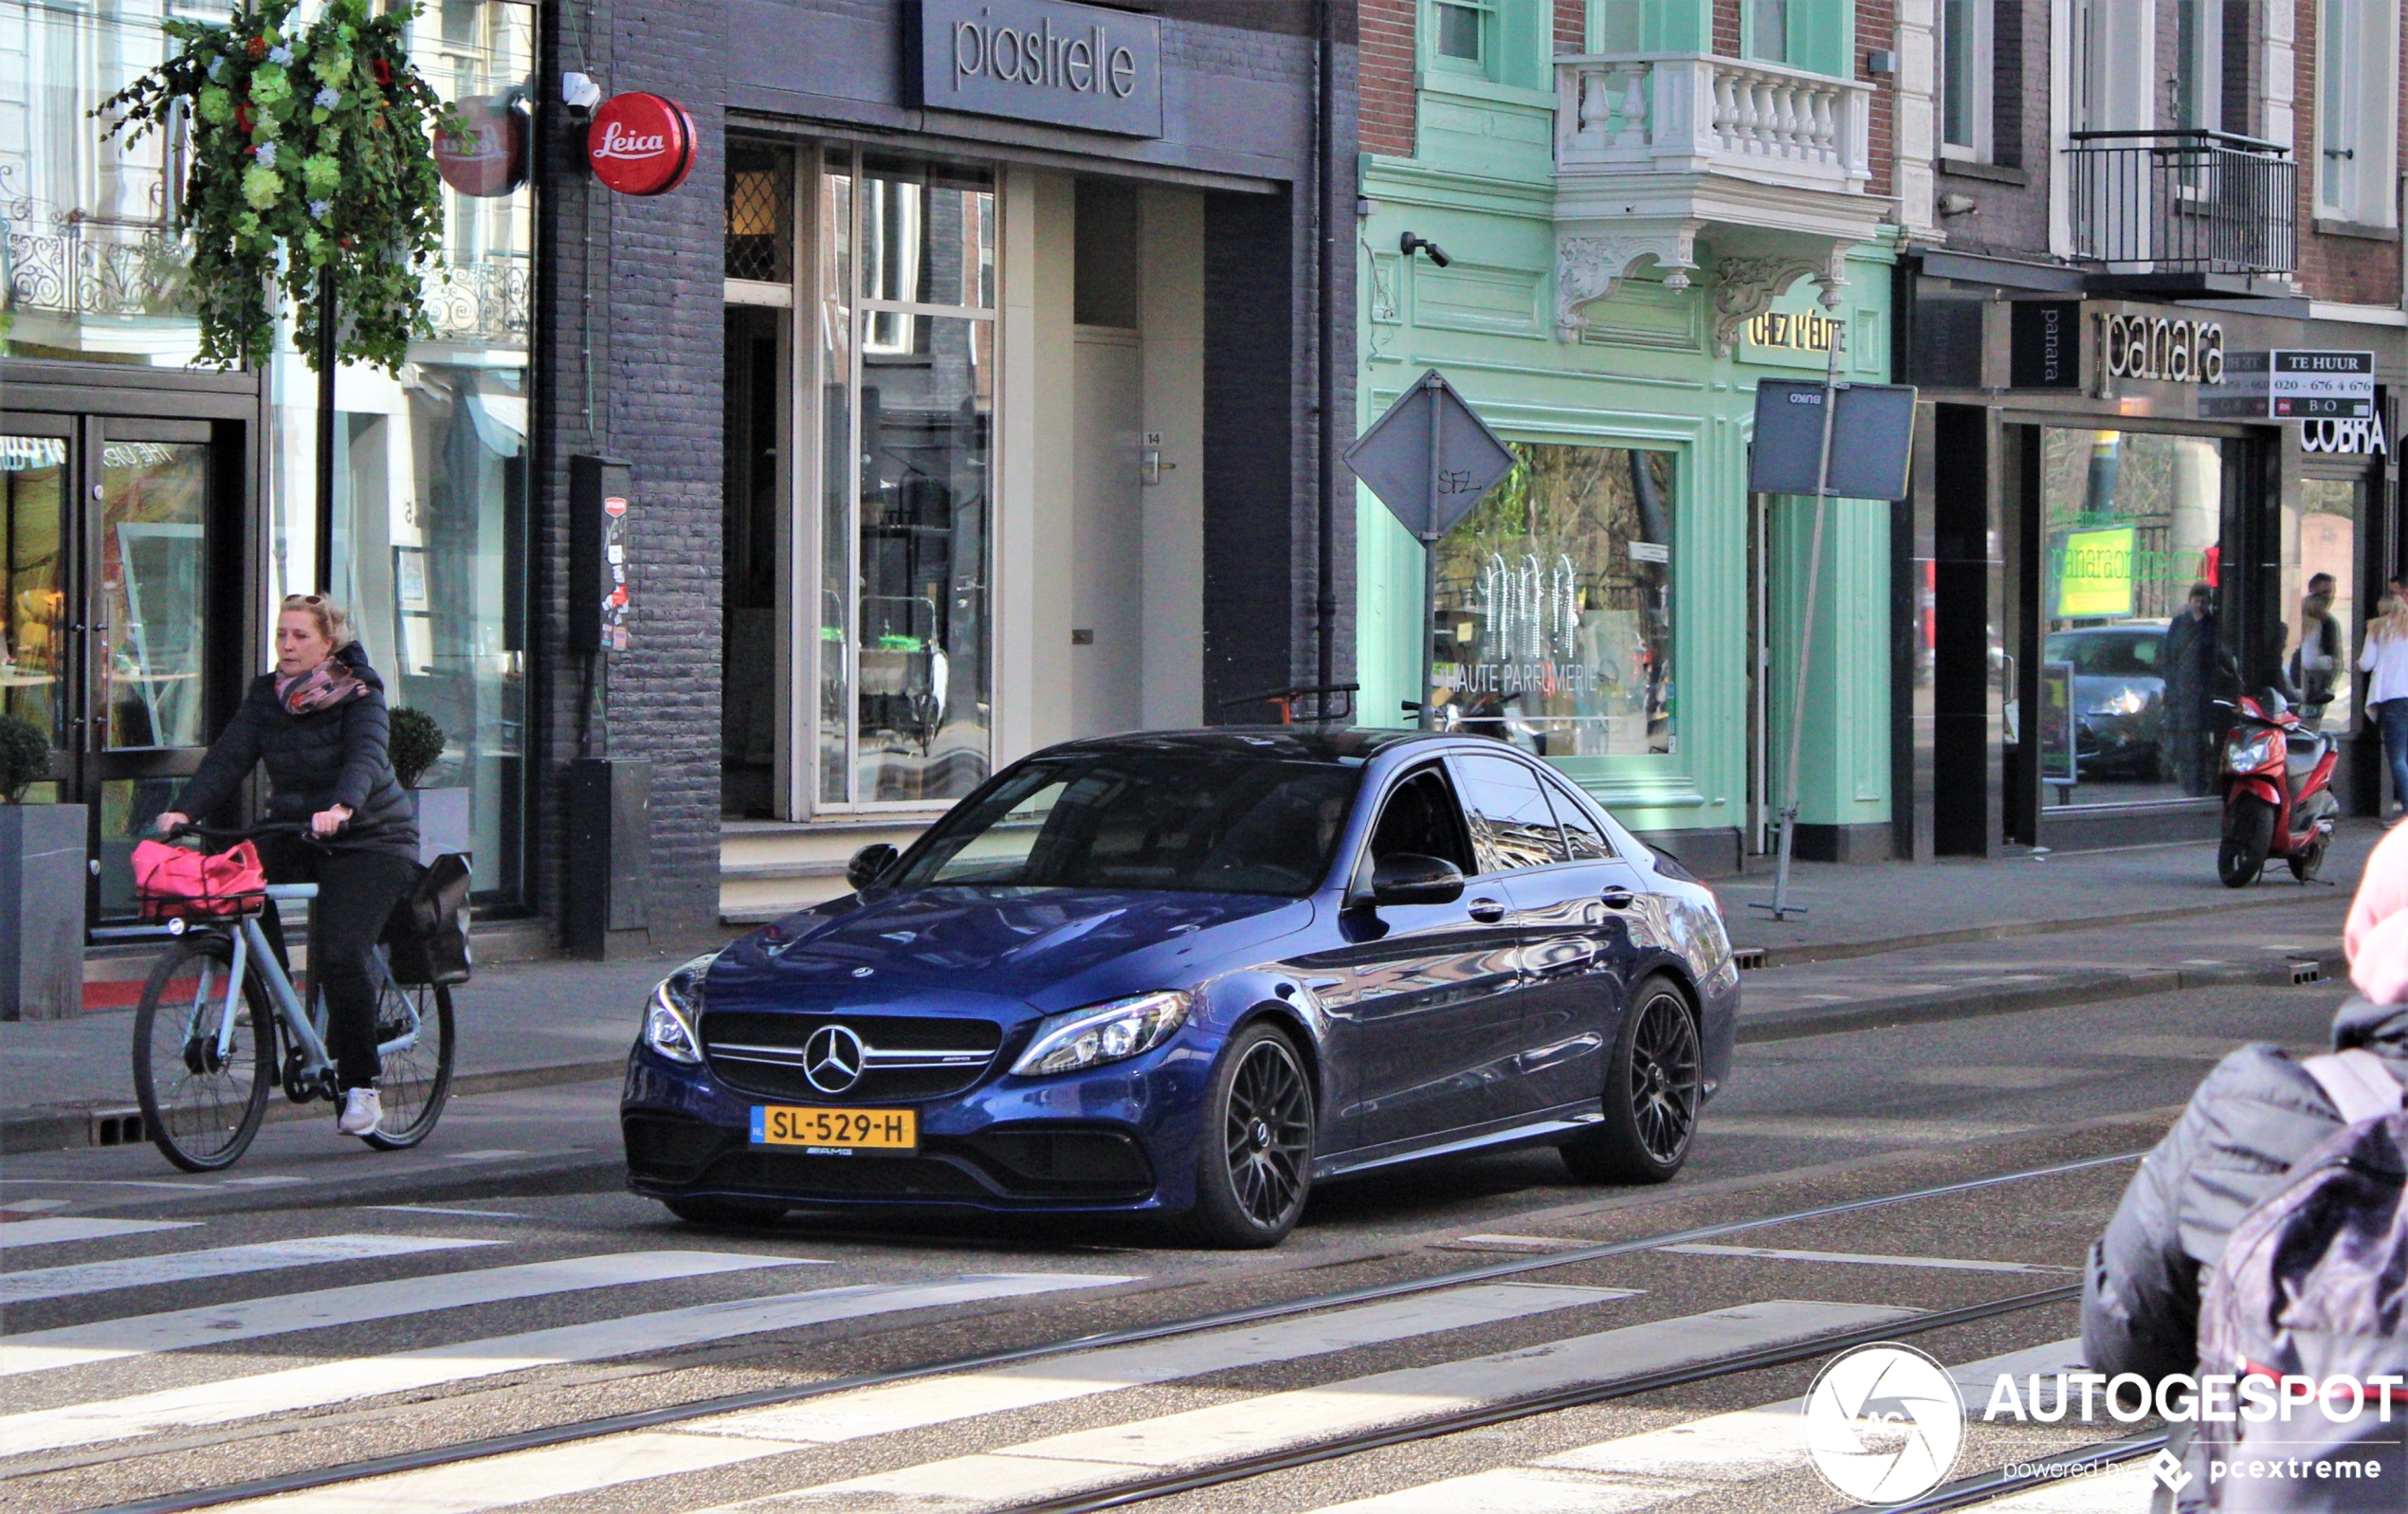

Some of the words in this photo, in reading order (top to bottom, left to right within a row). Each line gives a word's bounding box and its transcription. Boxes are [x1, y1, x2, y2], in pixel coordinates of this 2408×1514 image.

[952, 7, 1136, 98] piastrelle
[593, 121, 665, 159] Leica
[1748, 312, 1790, 347] CHEZ
[2041, 309, 2059, 381] panara
[2096, 312, 2226, 400] panara
[2289, 356, 2308, 370] TE
[2312, 357, 2360, 371] HUUR
[1789, 392, 1821, 405] BUKO
[2275, 380, 2298, 391] 020
[2310, 380, 2332, 391] 676
[2337, 380, 2345, 391] 4
[2349, 380, 2371, 392] 676
[1148, 433, 1159, 445] 14
[2301, 409, 2387, 455] COBRA
[1445, 664, 1499, 693] HAUTE
[1504, 664, 1598, 693] PARFUMERIE
[752, 1126, 764, 1137] NL
[773, 1111, 903, 1142] SL-529-H
